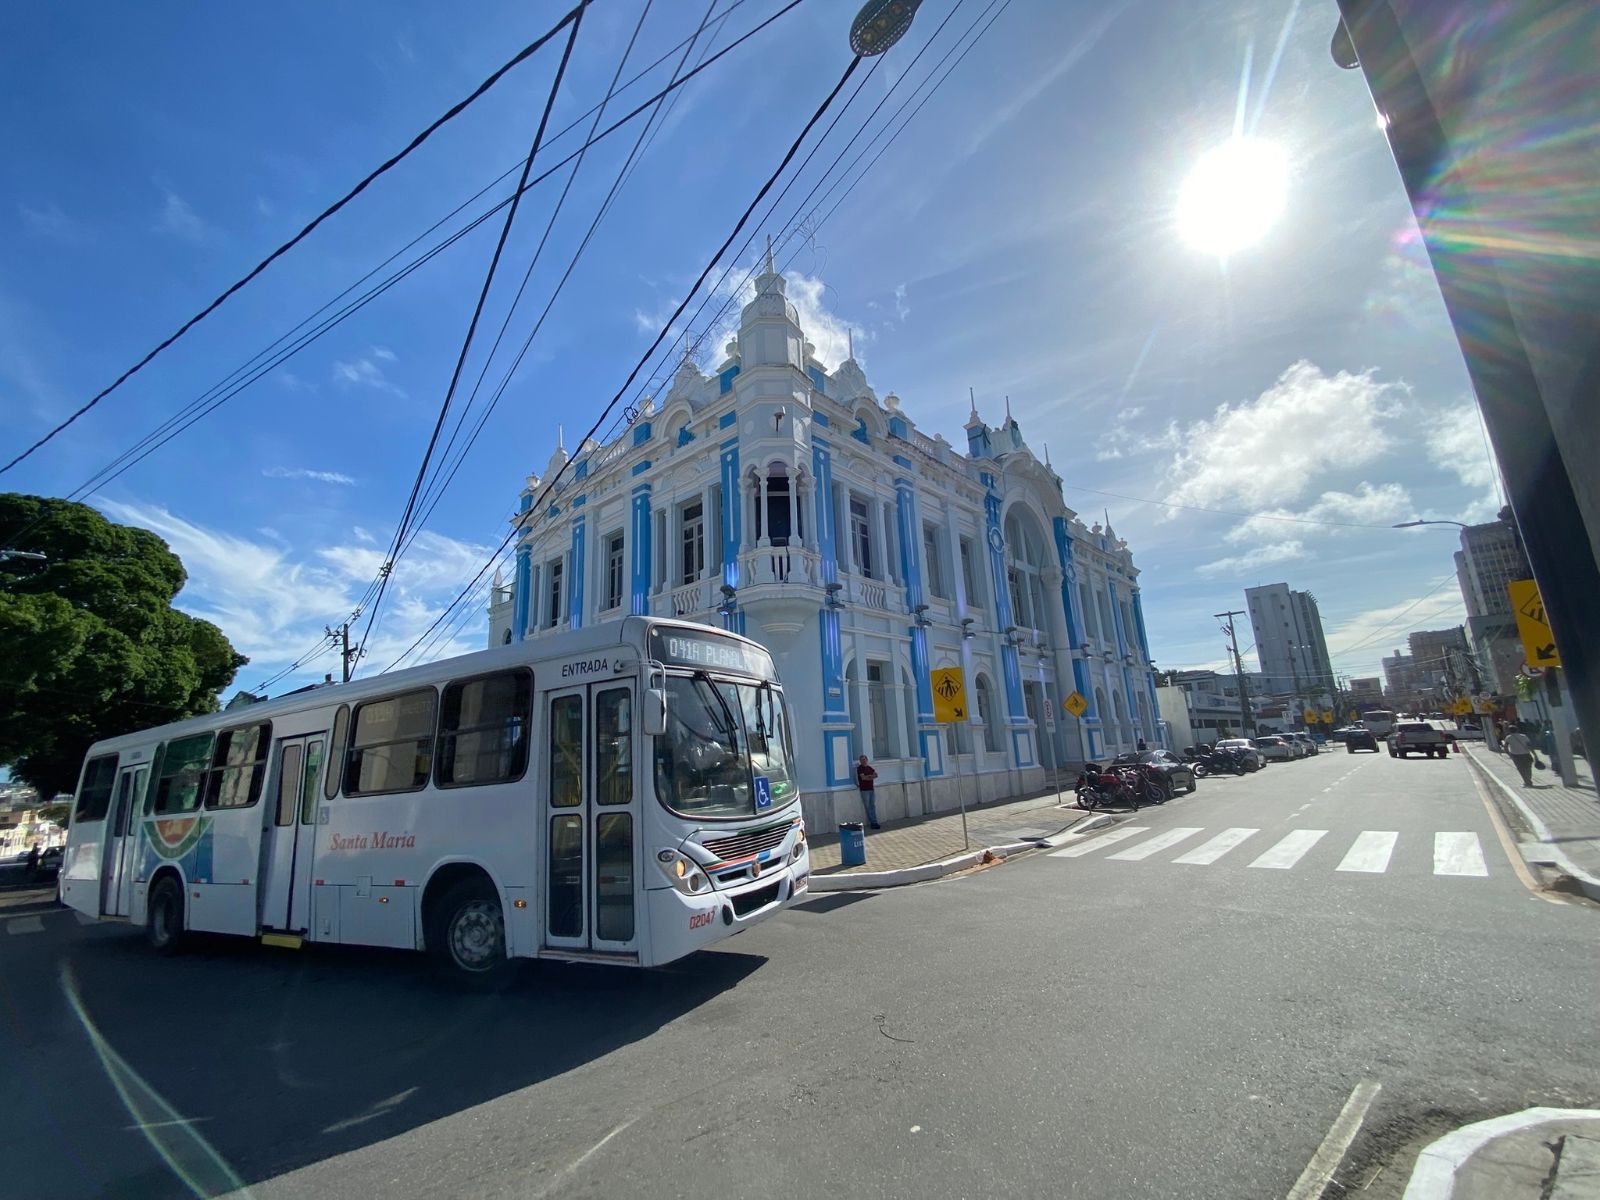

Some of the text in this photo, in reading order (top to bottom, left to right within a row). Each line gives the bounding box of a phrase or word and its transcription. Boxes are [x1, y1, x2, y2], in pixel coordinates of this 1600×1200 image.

[561, 658, 608, 677] ENTRADA
[329, 830, 416, 850] Santa Maria
[689, 910, 716, 930] 02047
